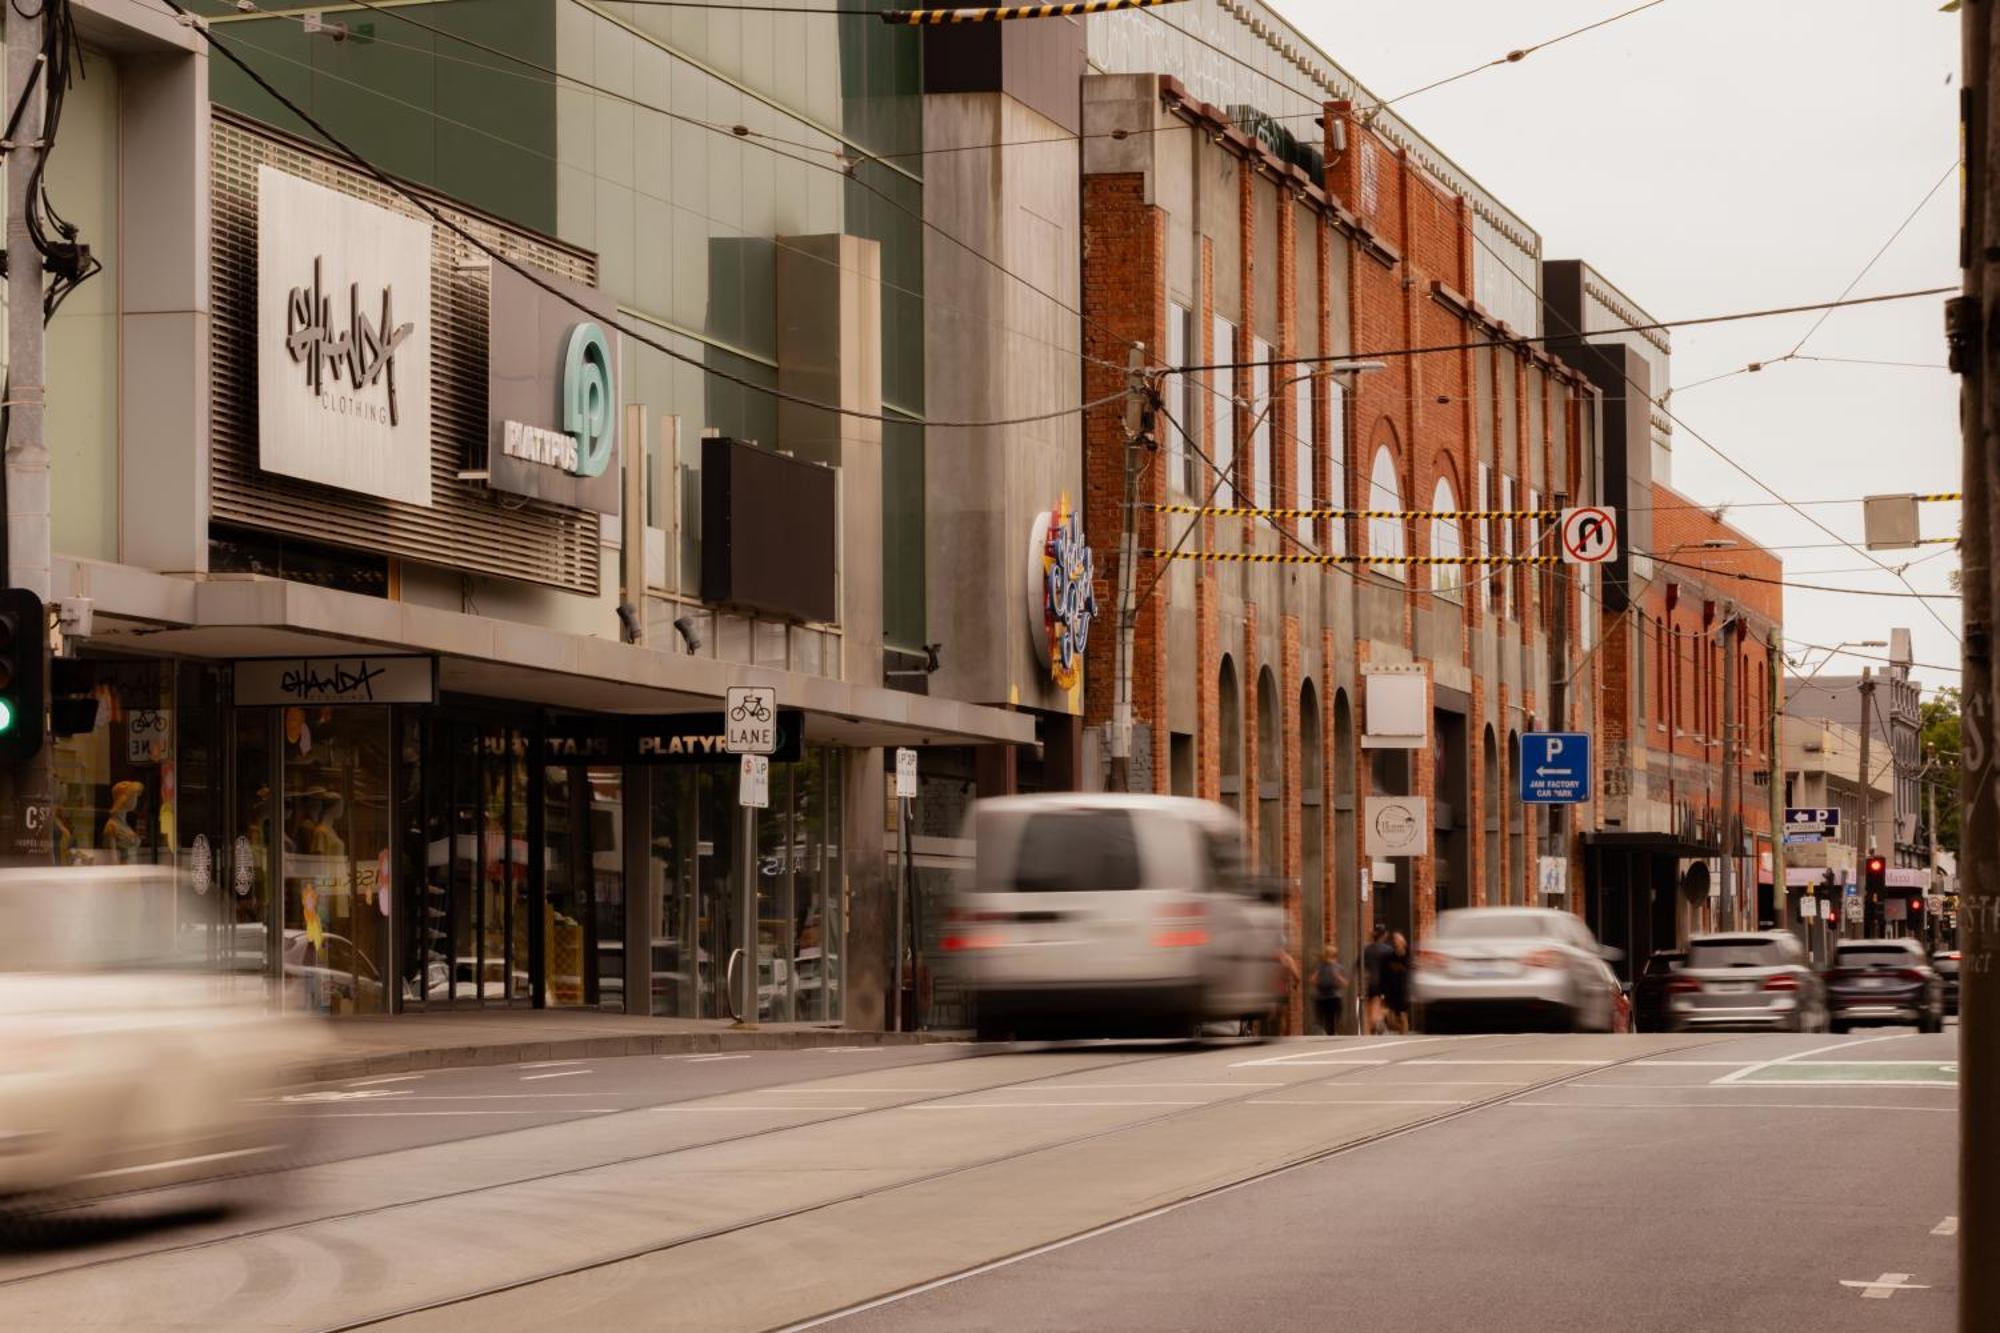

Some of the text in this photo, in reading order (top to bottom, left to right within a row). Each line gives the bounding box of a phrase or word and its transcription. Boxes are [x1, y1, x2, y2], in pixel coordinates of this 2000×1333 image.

[321, 390, 387, 424] CLOTHING
[503, 419, 578, 474] PLATYPUS
[639, 736, 726, 754] PLATYP
[730, 729, 771, 744] LANE
[1546, 738, 1564, 762] P
[1531, 780, 1579, 788] JAM FACTORY
[1536, 789, 1573, 798] CAR PARK
